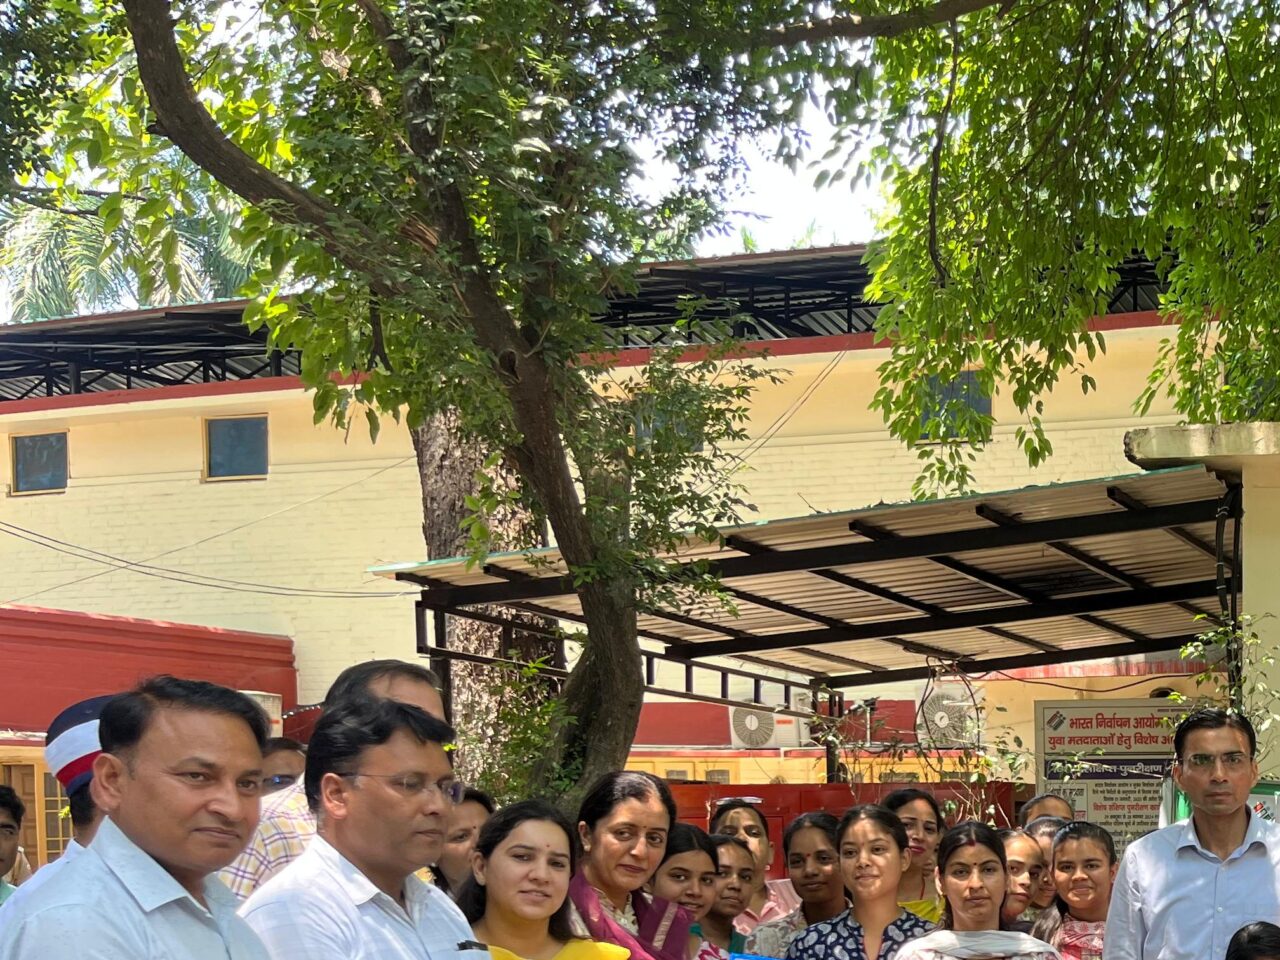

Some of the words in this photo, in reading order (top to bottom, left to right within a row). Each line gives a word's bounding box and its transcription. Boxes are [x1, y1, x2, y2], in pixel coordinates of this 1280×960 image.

[1069, 716, 1093, 729] भारत
[1095, 713, 1130, 729] निर्वाचन
[1048, 736, 1065, 750] युवा
[1067, 732, 1115, 746] मतदाताओं
[1116, 733, 1132, 750] हेतु
[1134, 732, 1159, 745] विशेष
